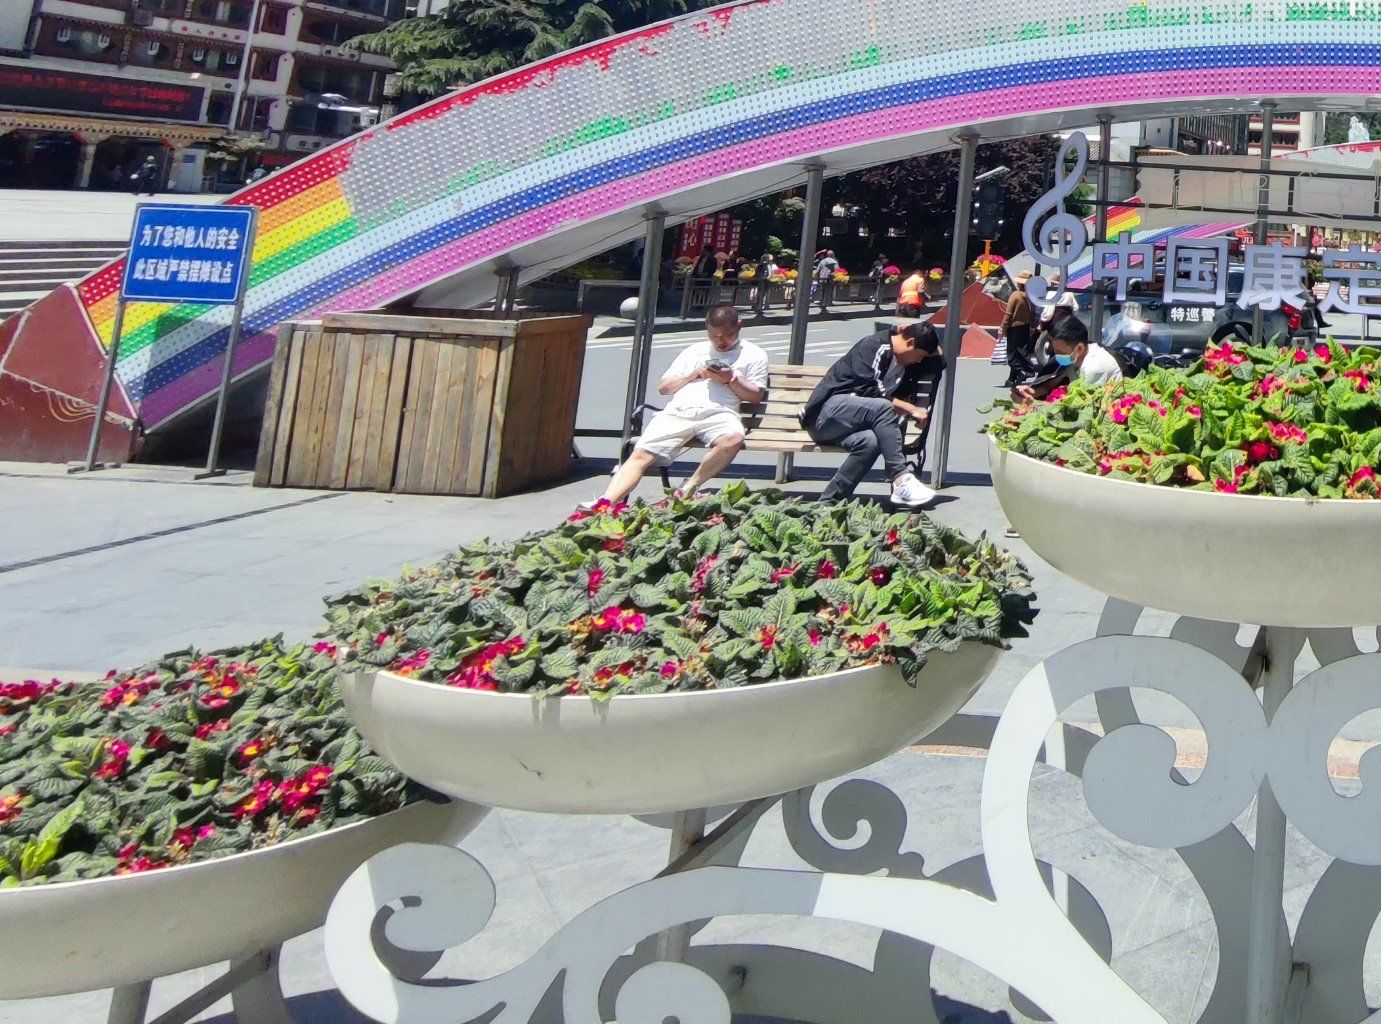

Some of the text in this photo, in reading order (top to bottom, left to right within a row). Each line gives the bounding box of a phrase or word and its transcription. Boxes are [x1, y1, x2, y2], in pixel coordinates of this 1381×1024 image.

[140, 224, 240, 249] 为了您和他人的安全
[1170, 307, 1216, 322] 特巡警
